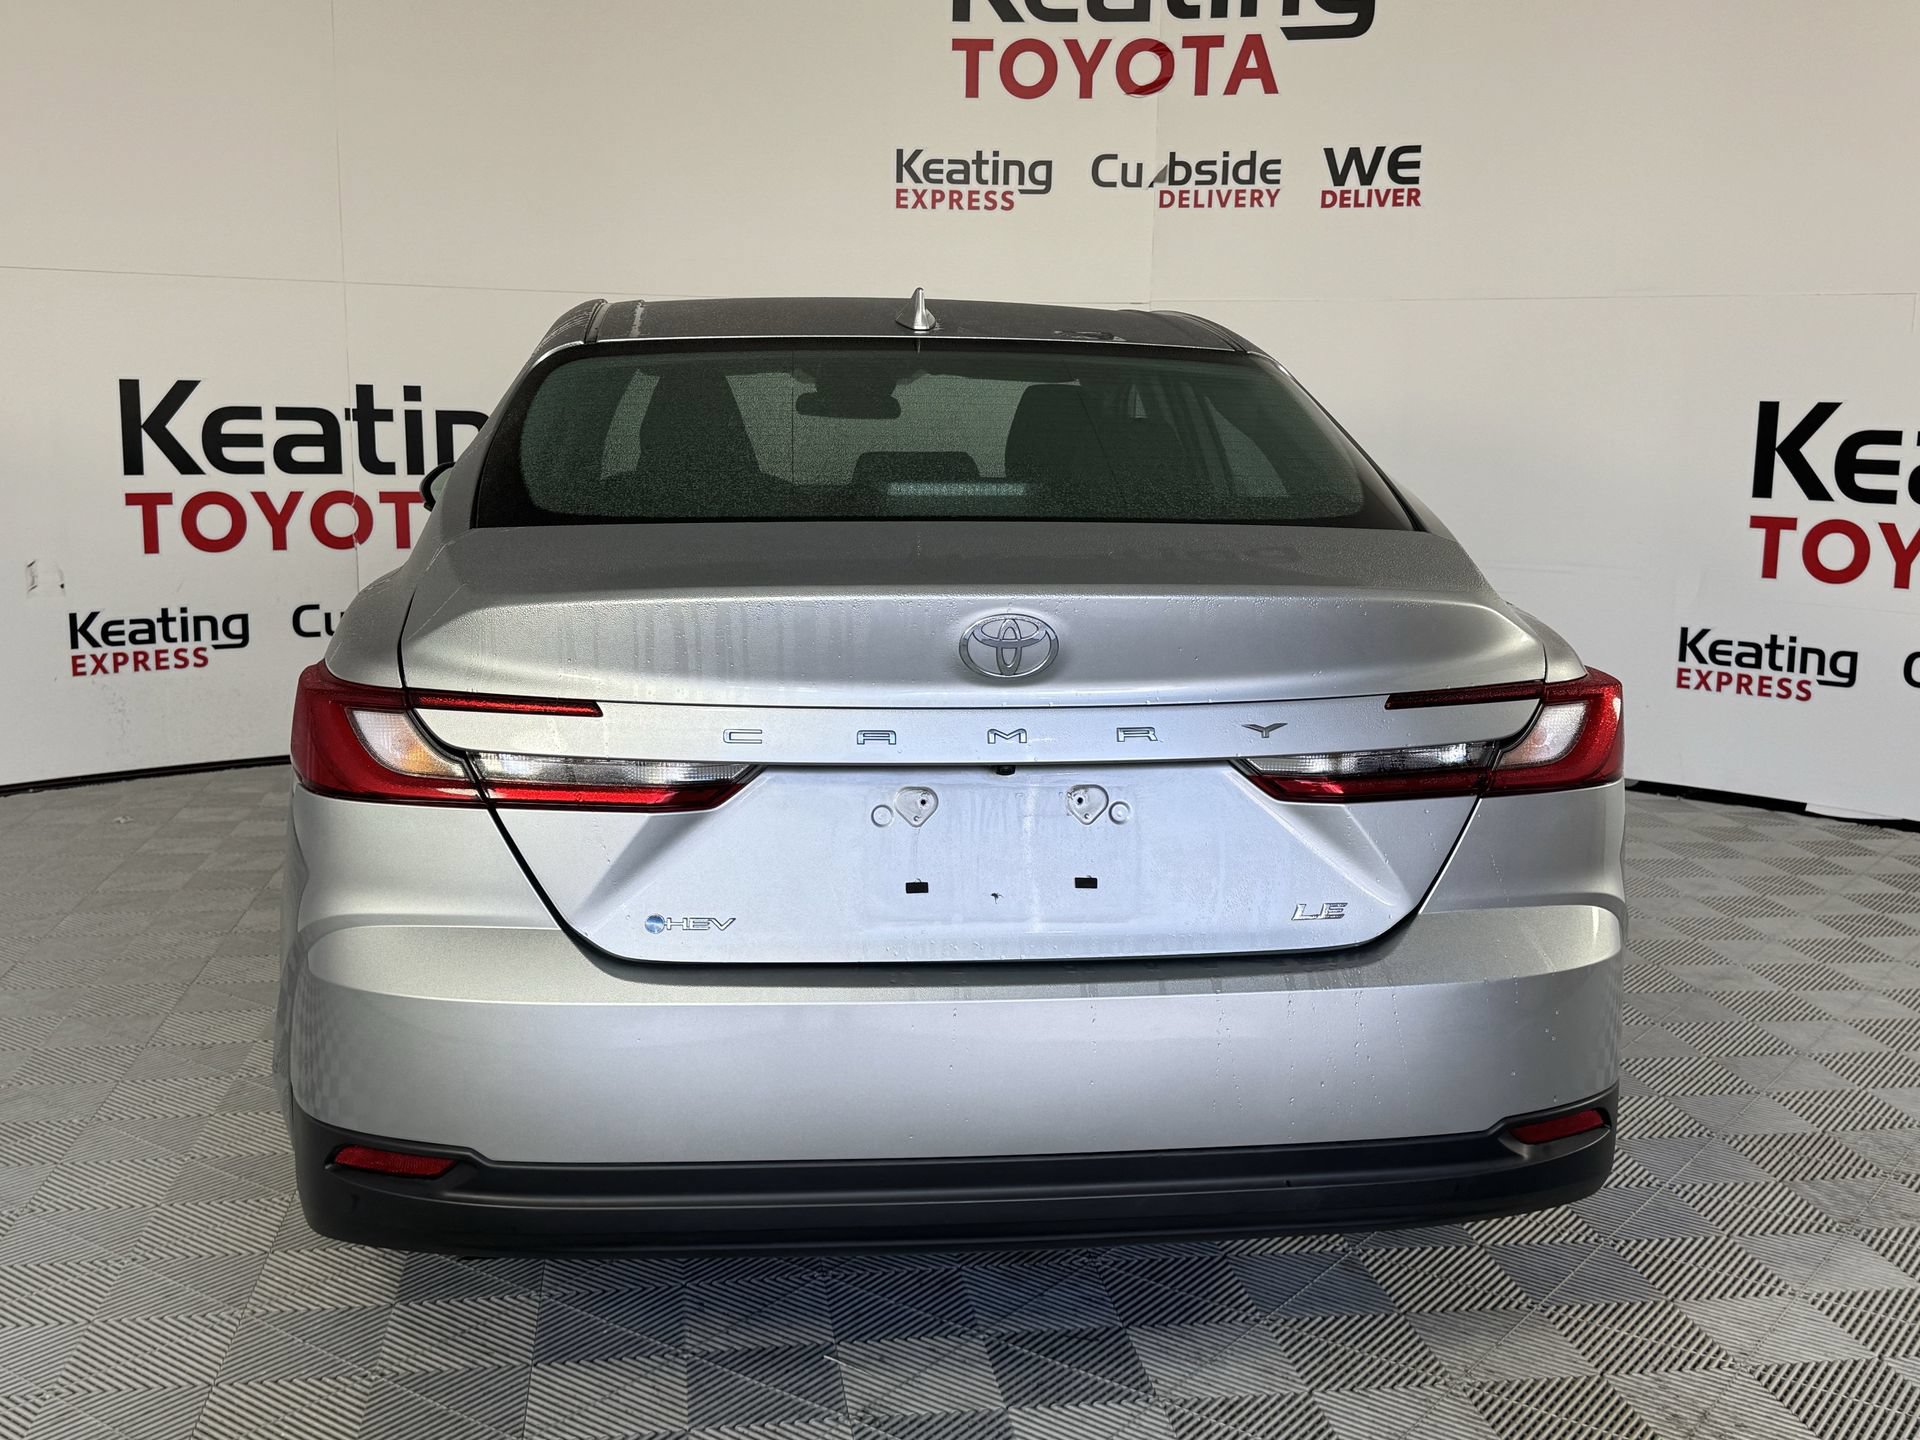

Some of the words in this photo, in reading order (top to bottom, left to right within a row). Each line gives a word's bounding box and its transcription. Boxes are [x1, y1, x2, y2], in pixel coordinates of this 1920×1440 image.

[951, 33, 1279, 99] TOYOTA
[895, 148, 1053, 195] Keating
[1091, 150, 1282, 188] Cubside
[1323, 145, 1422, 187] WE
[896, 188, 1015, 211] EXPRESS
[1158, 188, 1281, 209] DELIVERY
[1320, 187, 1422, 209] DELIVER
[68, 606, 250, 651] Keating
[71, 646, 210, 677] EXPRESS
[1677, 626, 1859, 689] Keating
[1675, 667, 1813, 702] EXPRESS
[722, 721, 1289, 746] CAMRY
[664, 916, 737, 932] HEV
[1290, 902, 1349, 921] LE
